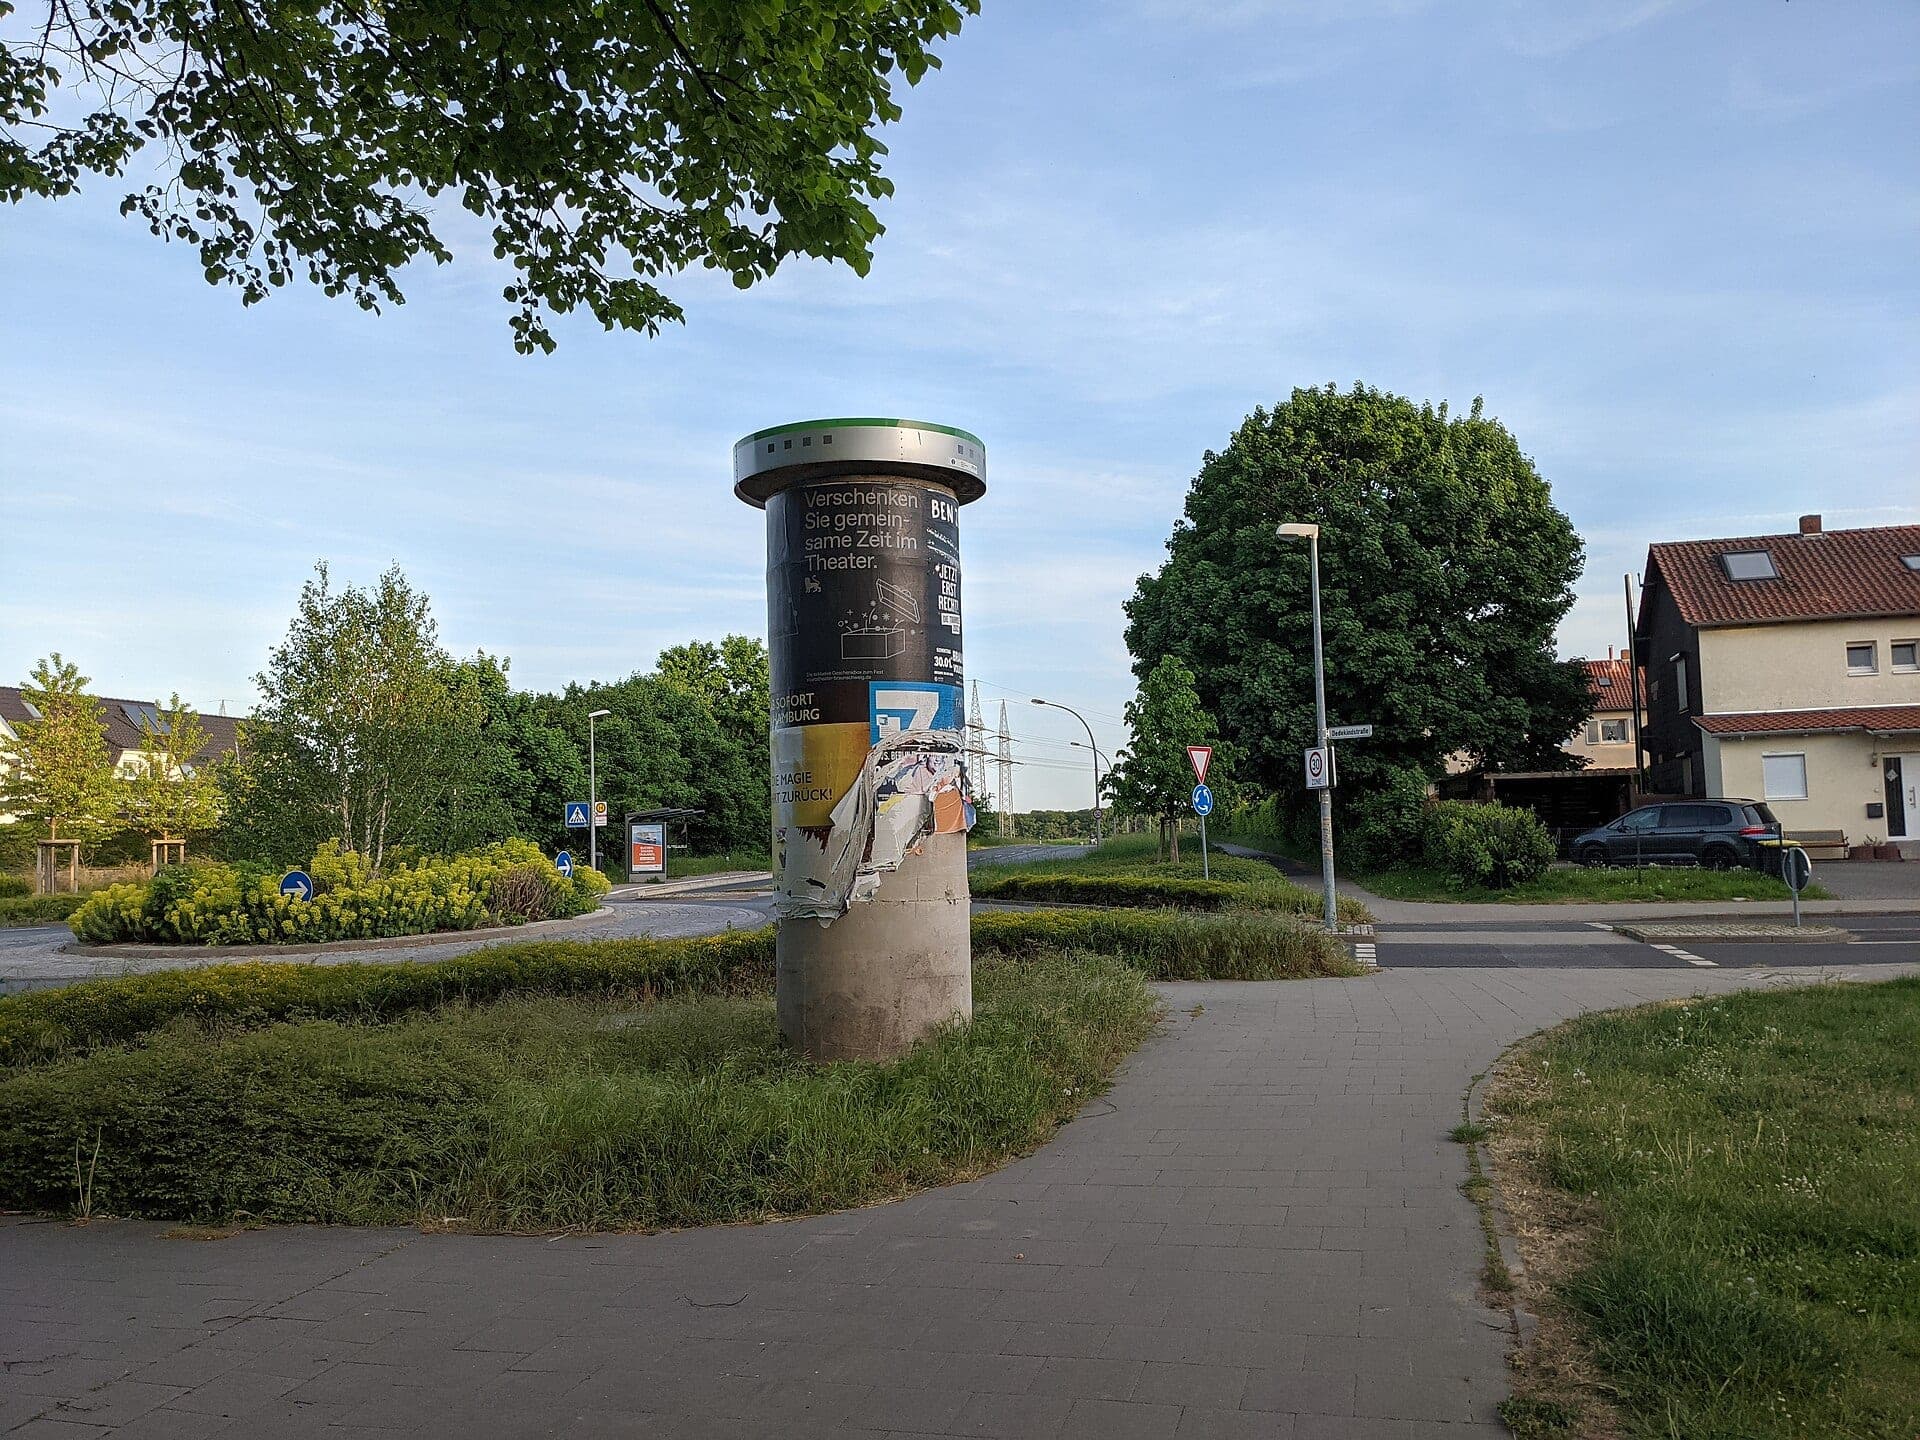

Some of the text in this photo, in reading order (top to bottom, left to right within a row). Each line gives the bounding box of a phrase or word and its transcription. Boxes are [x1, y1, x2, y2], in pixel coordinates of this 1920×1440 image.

[804, 488, 918, 508] Verschenken
[805, 510, 910, 531] Sie gemein-
[805, 534, 852, 551] same
[856, 530, 892, 548] Zeit
[896, 531, 917, 550] im
[804, 553, 878, 571] Theater.
[1311, 758, 1320, 771] 30
[780, 771, 812, 786] MAGIE
[782, 786, 833, 803] ZURÜCK!
